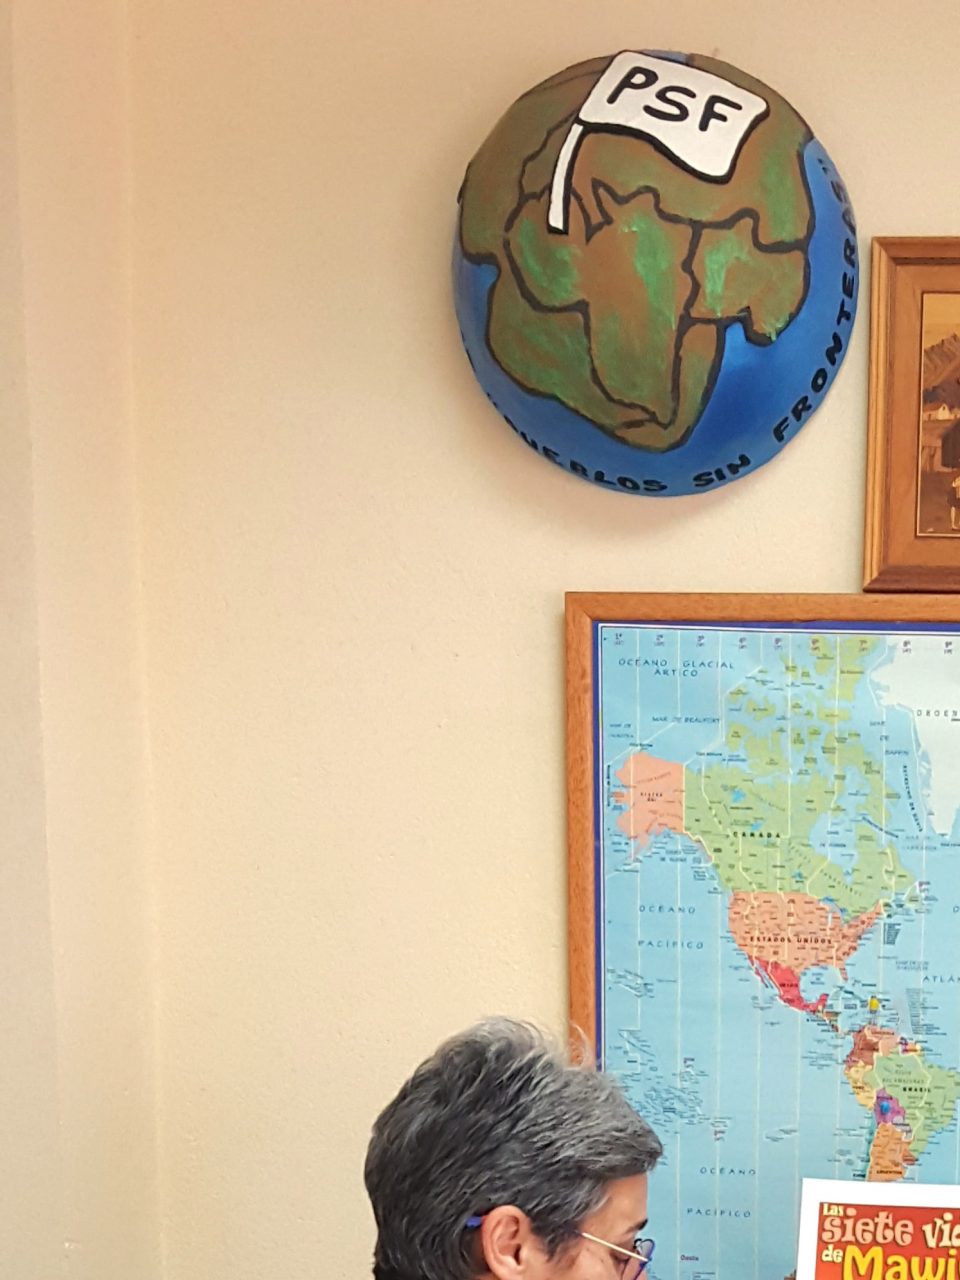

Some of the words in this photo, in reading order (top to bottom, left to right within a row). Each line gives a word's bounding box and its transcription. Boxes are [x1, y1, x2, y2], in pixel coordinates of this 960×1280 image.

[606, 66, 742, 131] PSF
[692, 453, 751, 488] SIN
[682, 660, 734, 669] GLACIAL
[822, 1203, 844, 1216] Las
[821, 1207, 914, 1246] siete
[821, 1243, 843, 1263] de
